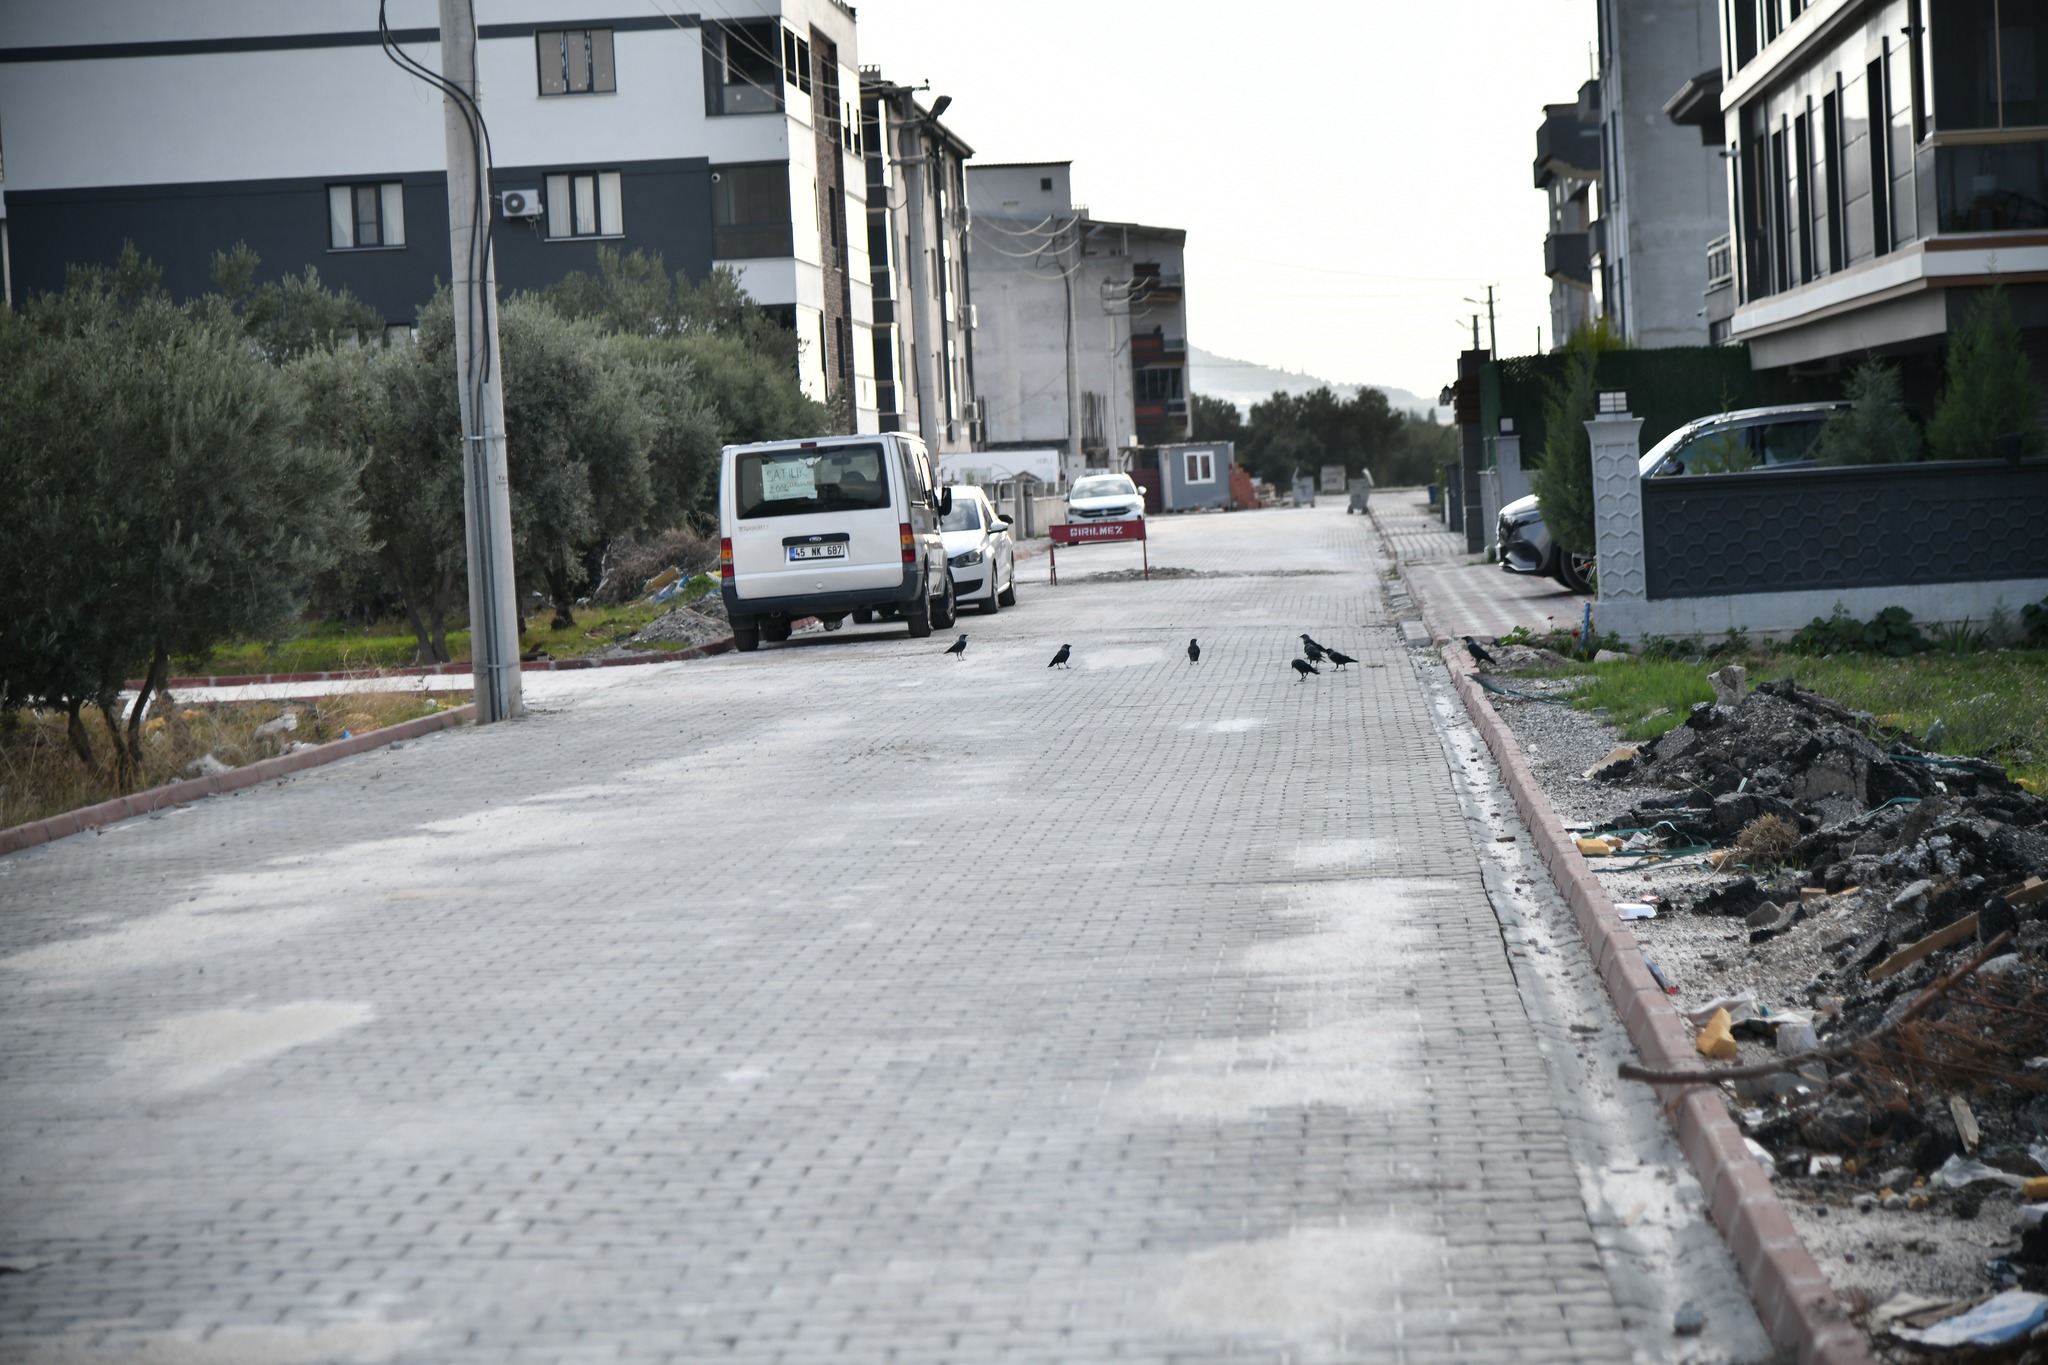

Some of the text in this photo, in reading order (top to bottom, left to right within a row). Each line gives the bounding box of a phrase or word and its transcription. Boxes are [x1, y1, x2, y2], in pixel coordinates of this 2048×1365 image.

[795, 545, 842, 558] 45 NK 687
